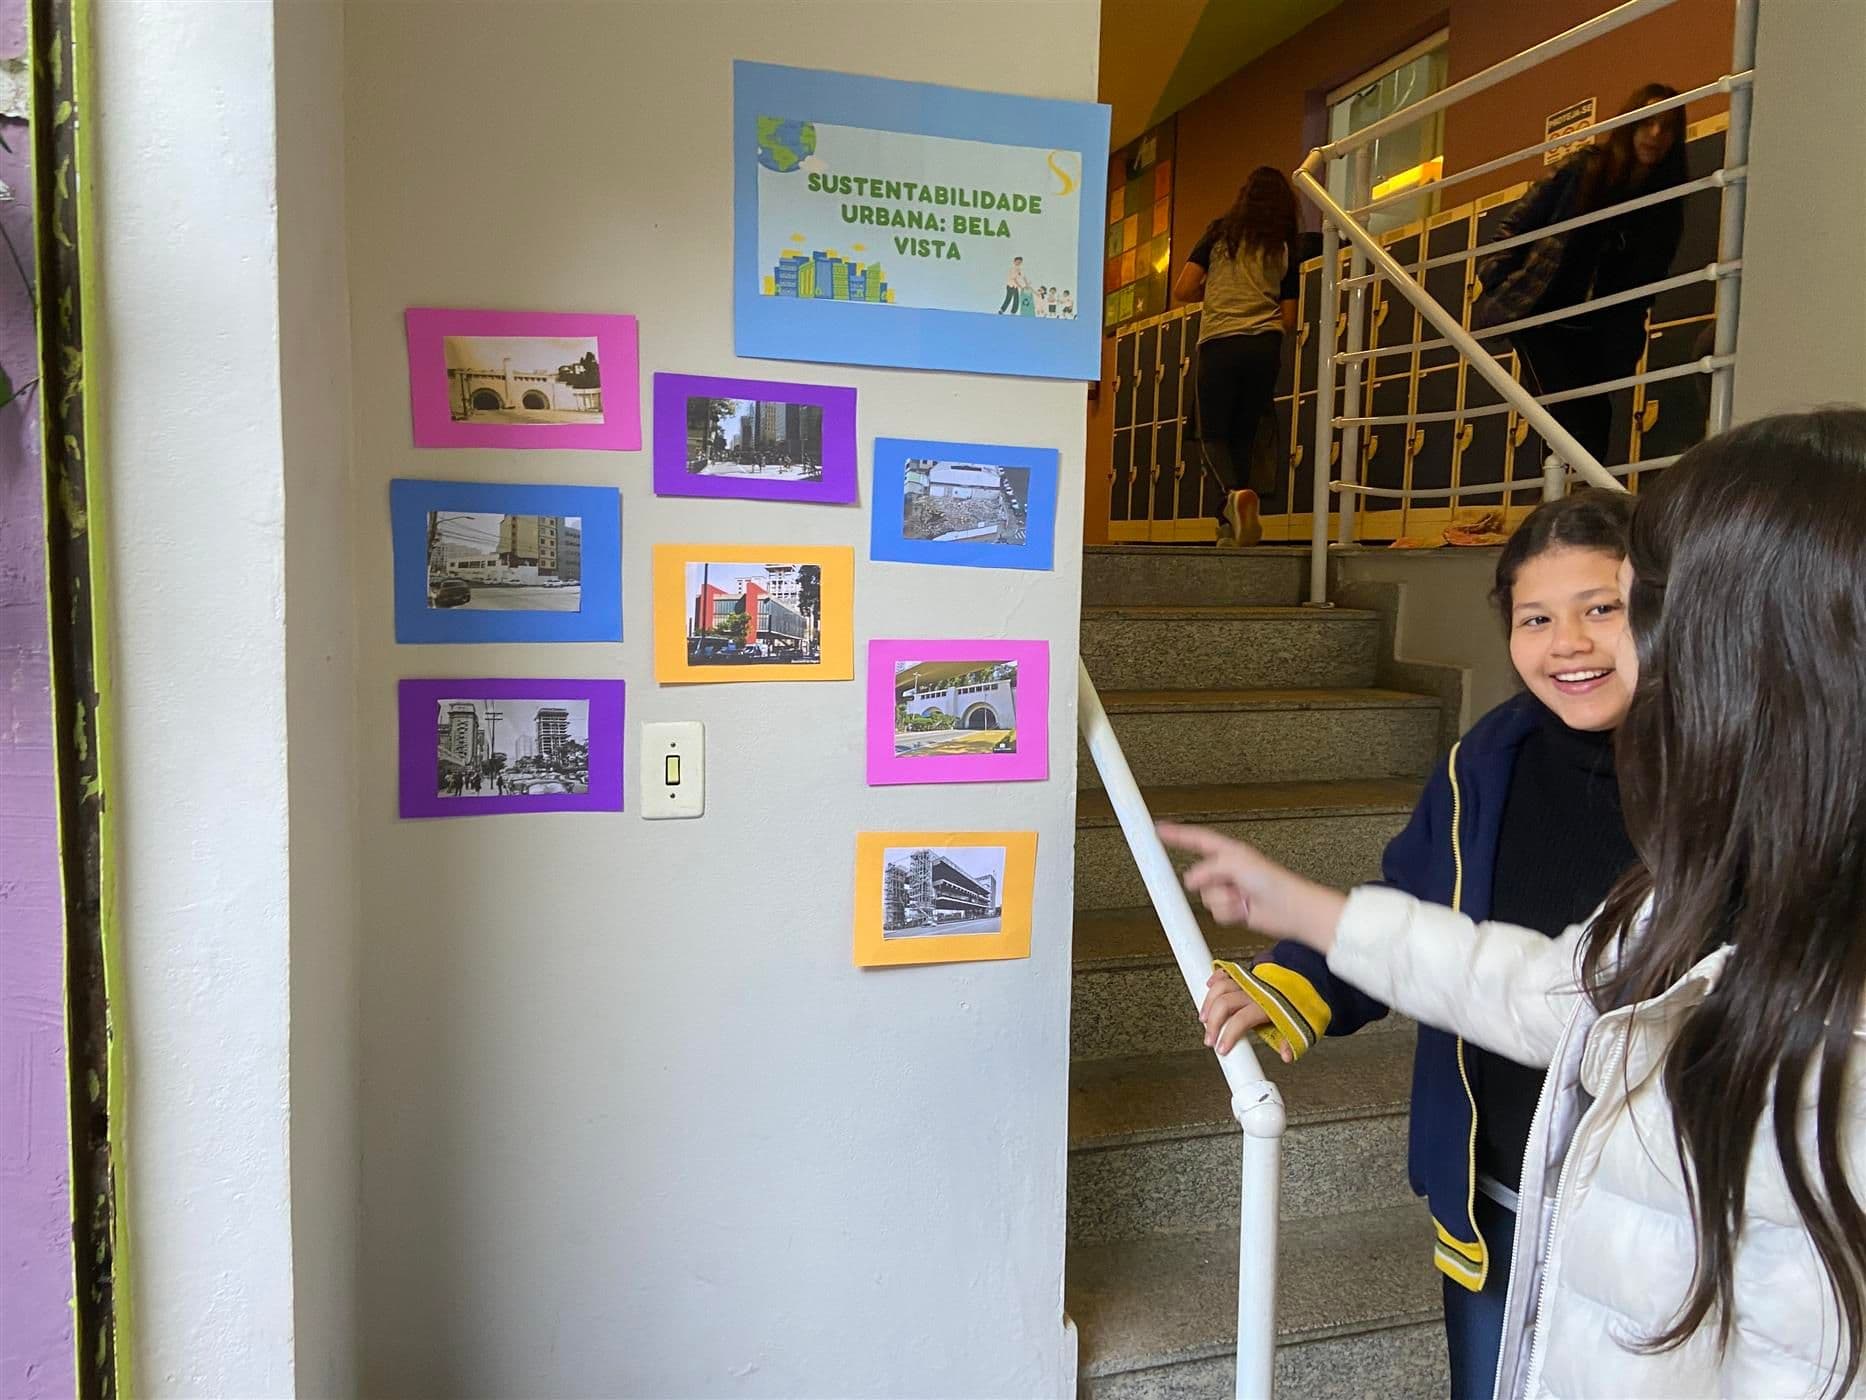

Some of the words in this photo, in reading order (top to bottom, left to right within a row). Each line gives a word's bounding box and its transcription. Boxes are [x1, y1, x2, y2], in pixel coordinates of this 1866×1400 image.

[807, 172, 1042, 214] SUSTENTABILIDADE
[841, 203, 946, 233] URBANA:
[952, 214, 1011, 239] BELA
[893, 235, 961, 261] VISTA
